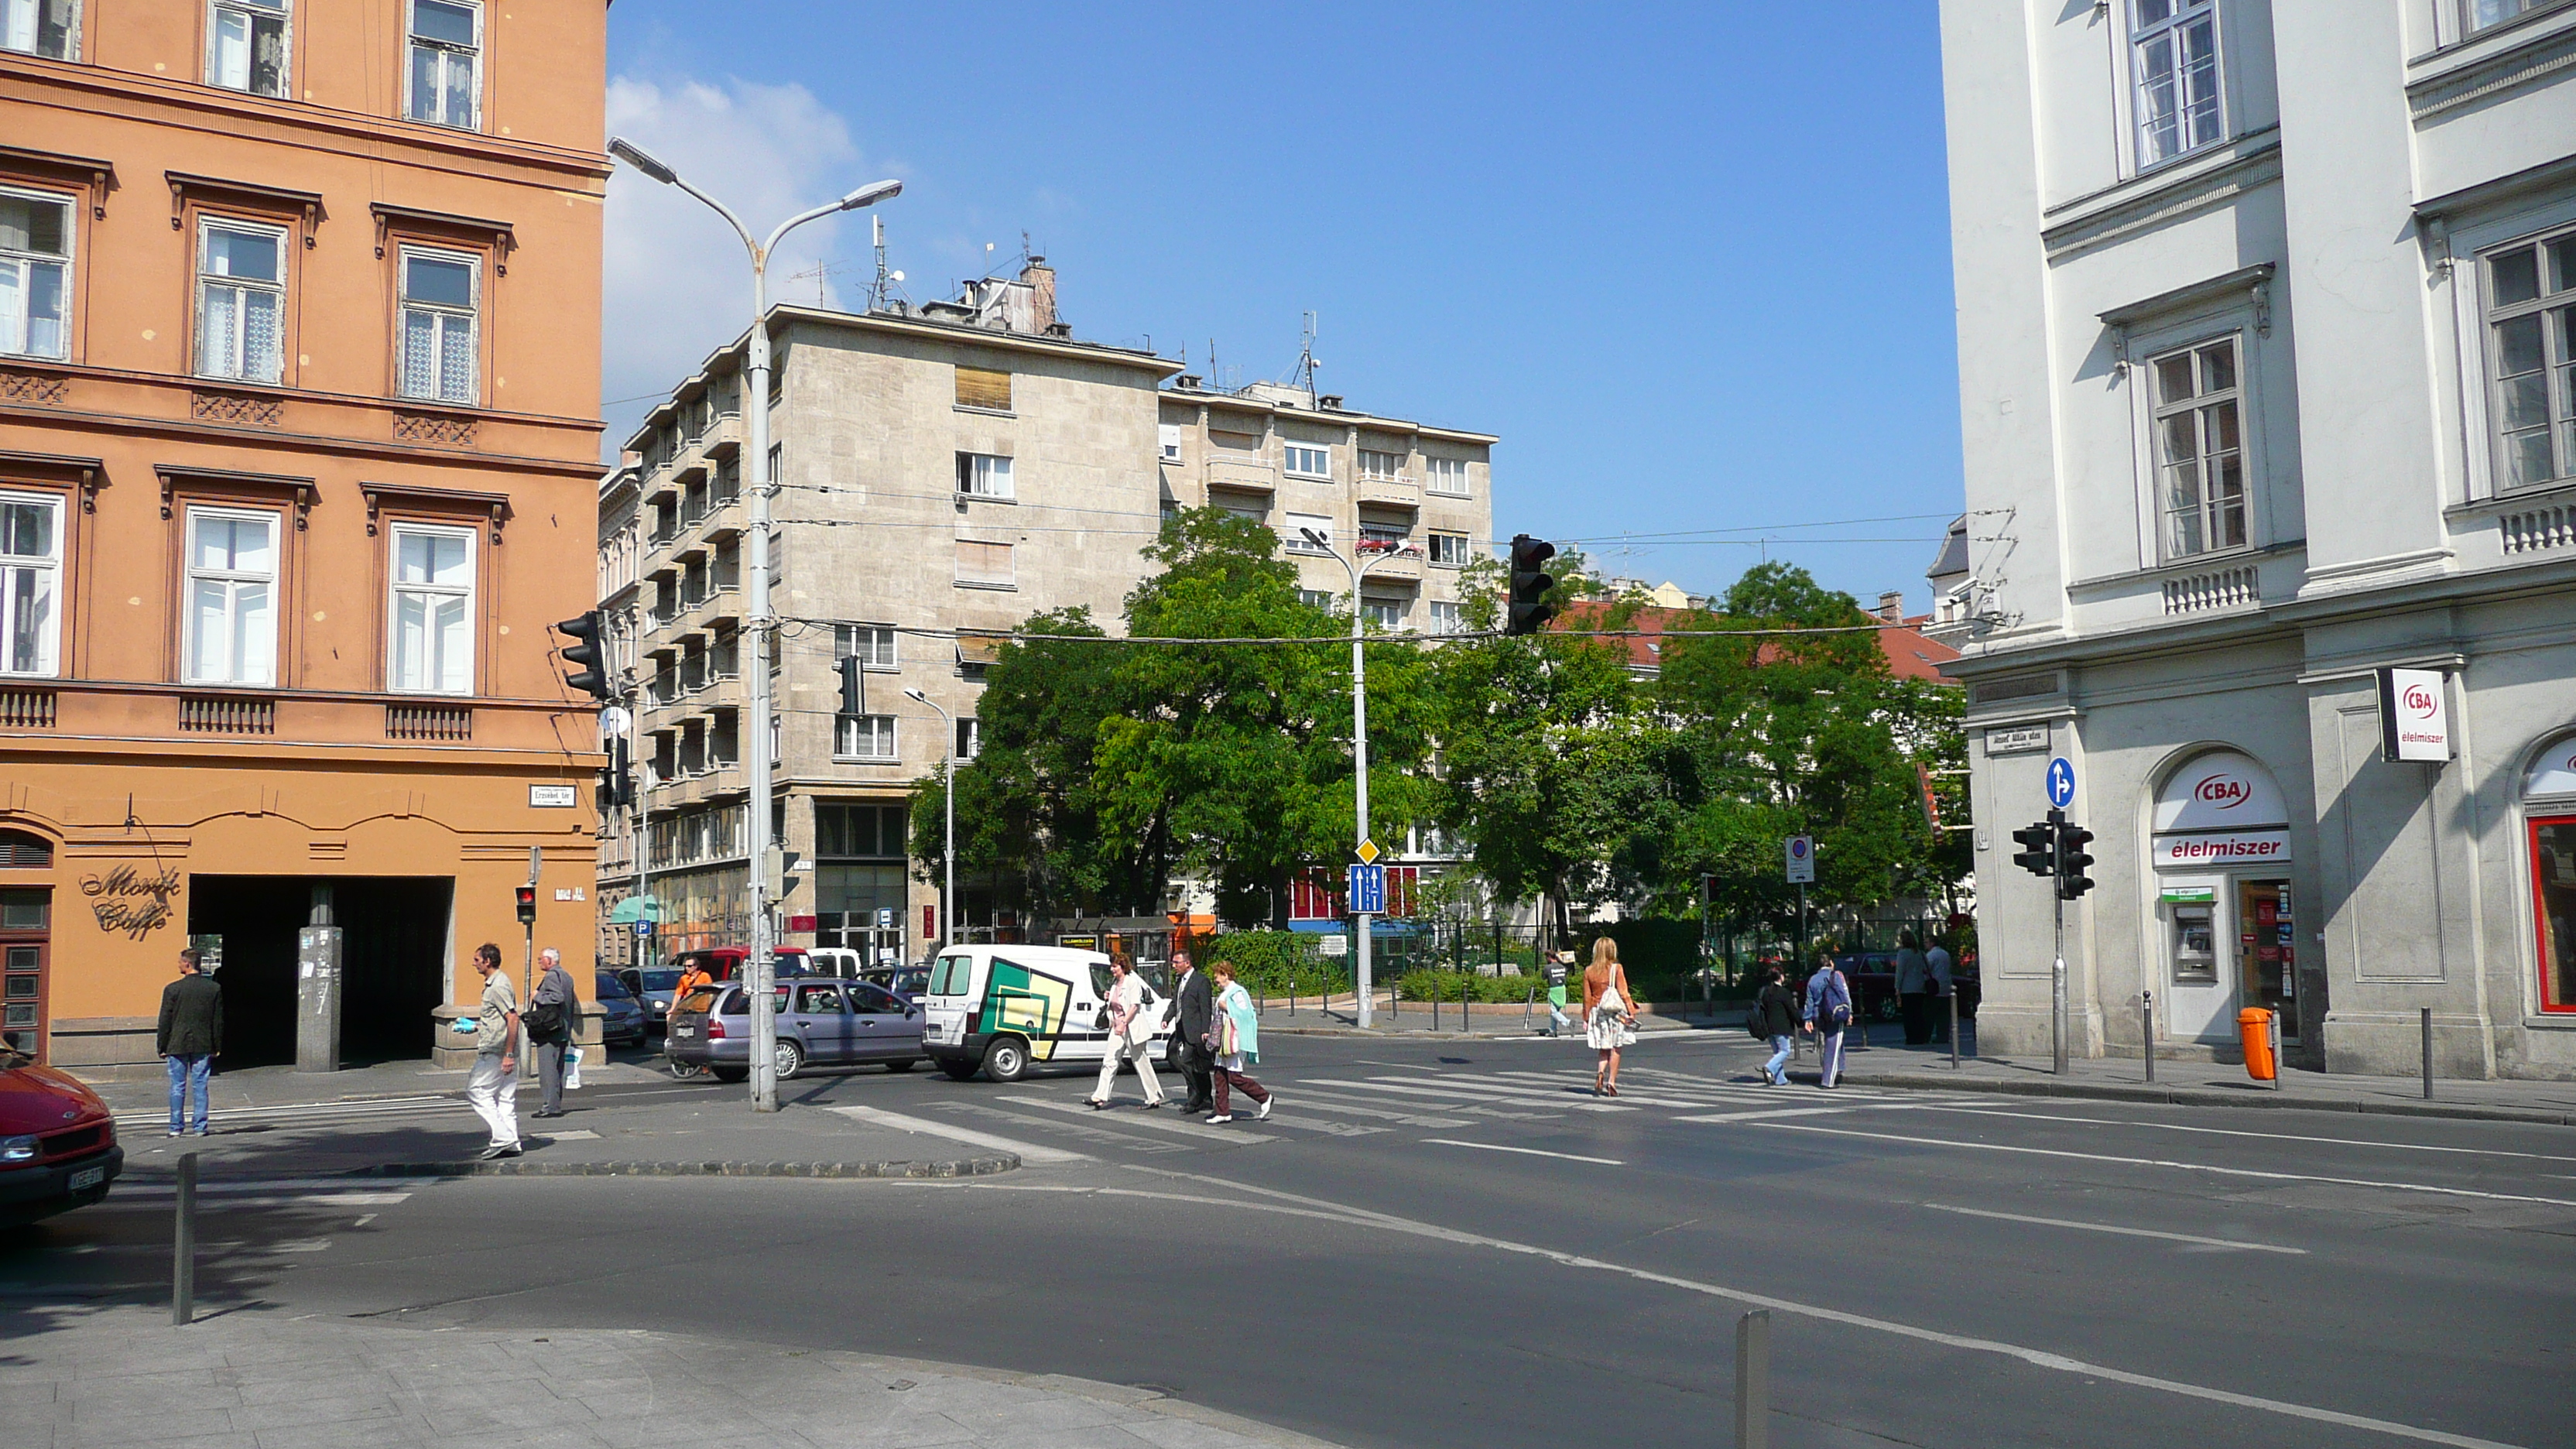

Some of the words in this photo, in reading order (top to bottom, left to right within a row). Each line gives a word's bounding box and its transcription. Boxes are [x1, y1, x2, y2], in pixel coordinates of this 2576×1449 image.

[2408, 692, 2432, 709] CBA
[2402, 731, 2444, 743] élelmiszer
[2202, 781, 2242, 801] CBA
[2171, 838, 2281, 858] élelmiszer
[639, 923, 647, 933] P
